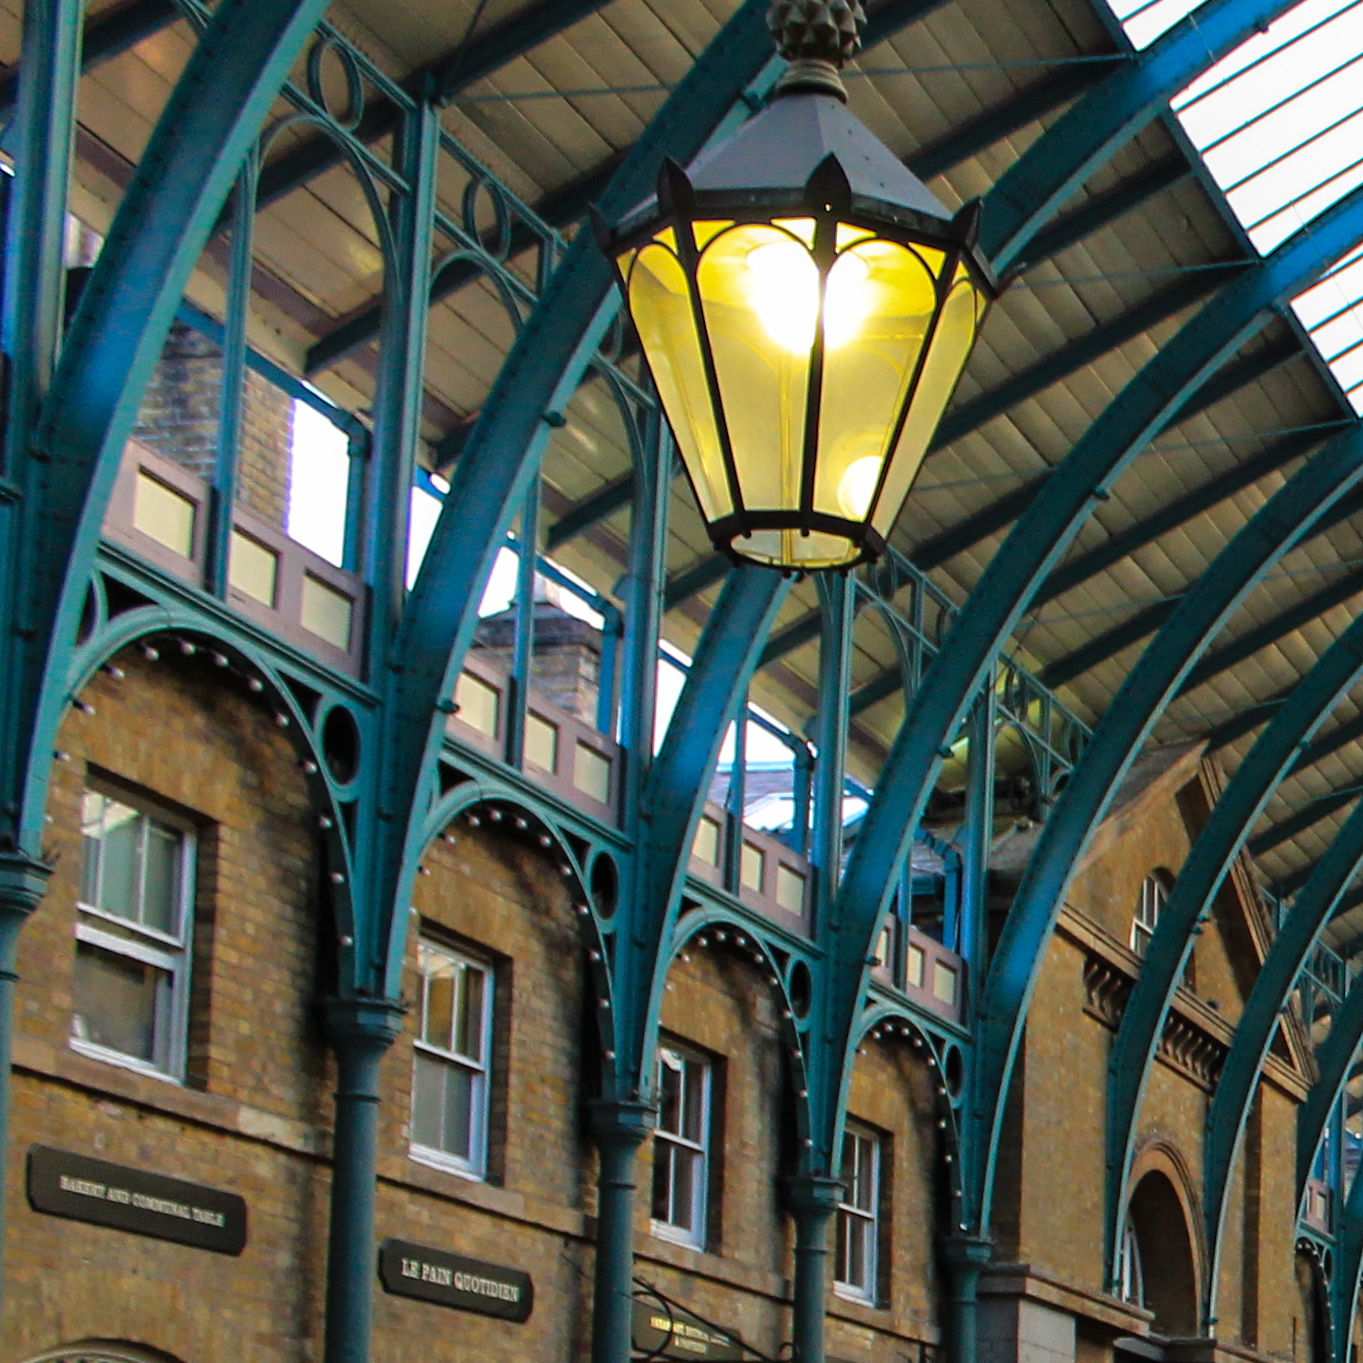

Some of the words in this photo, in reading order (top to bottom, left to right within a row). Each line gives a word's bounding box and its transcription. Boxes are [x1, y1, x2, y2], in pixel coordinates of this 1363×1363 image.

[401, 1258, 419, 1279] LE
[422, 1264, 450, 1285] PAIN
[454, 1271, 519, 1303] QUOTIDIEN
